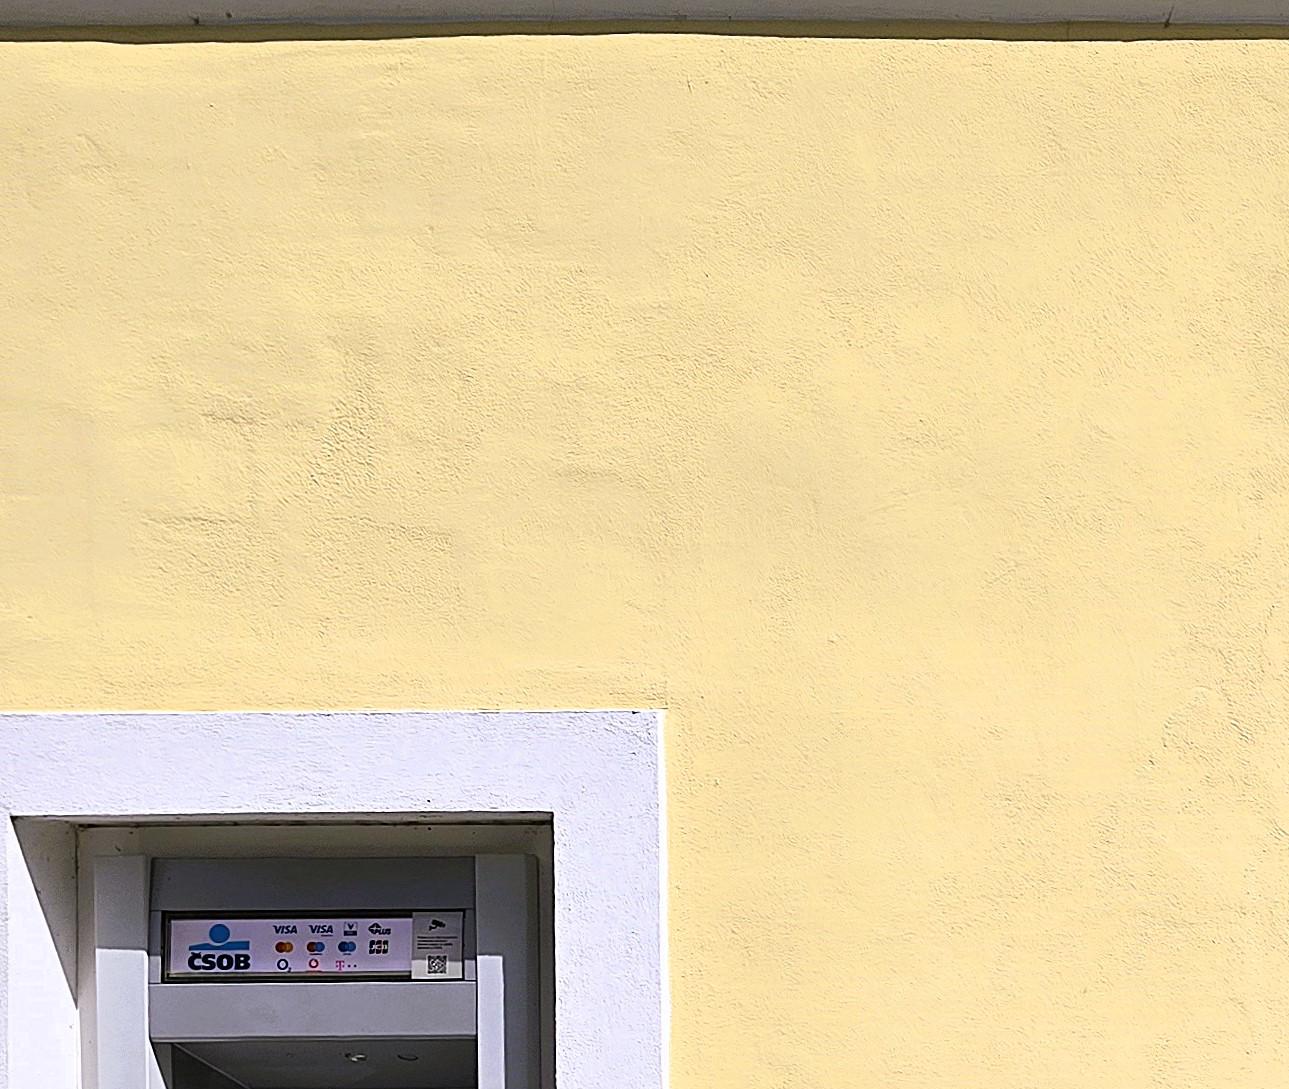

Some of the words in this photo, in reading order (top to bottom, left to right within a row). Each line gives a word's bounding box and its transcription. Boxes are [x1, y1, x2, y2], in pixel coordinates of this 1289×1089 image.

[273, 925, 298, 934] VISA
[308, 925, 334, 934] VISA
[187, 952, 251, 971] ČSOB
